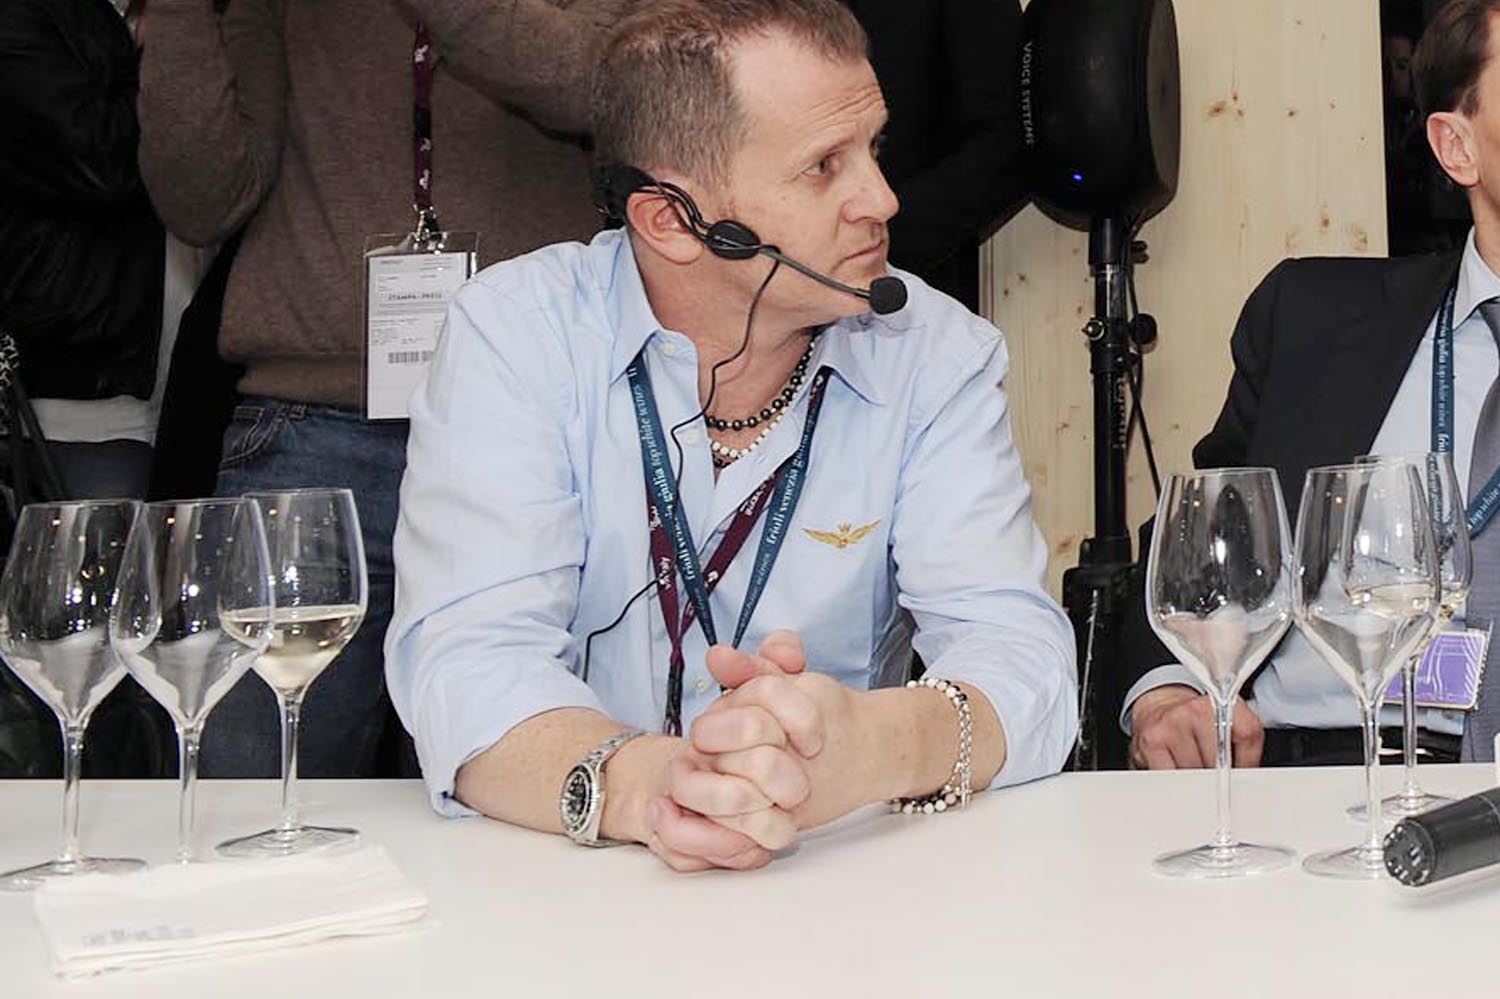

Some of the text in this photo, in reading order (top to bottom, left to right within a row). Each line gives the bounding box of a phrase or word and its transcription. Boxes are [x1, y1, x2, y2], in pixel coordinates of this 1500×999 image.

[1021, 41, 1034, 145] VOICE SYSTEMS
[1436, 432, 1449, 452] friu
[654, 467, 674, 503] giulia
[766, 511, 784, 545] friuli
[780, 467, 799, 512] venezia
[679, 548, 695, 581] friuli
